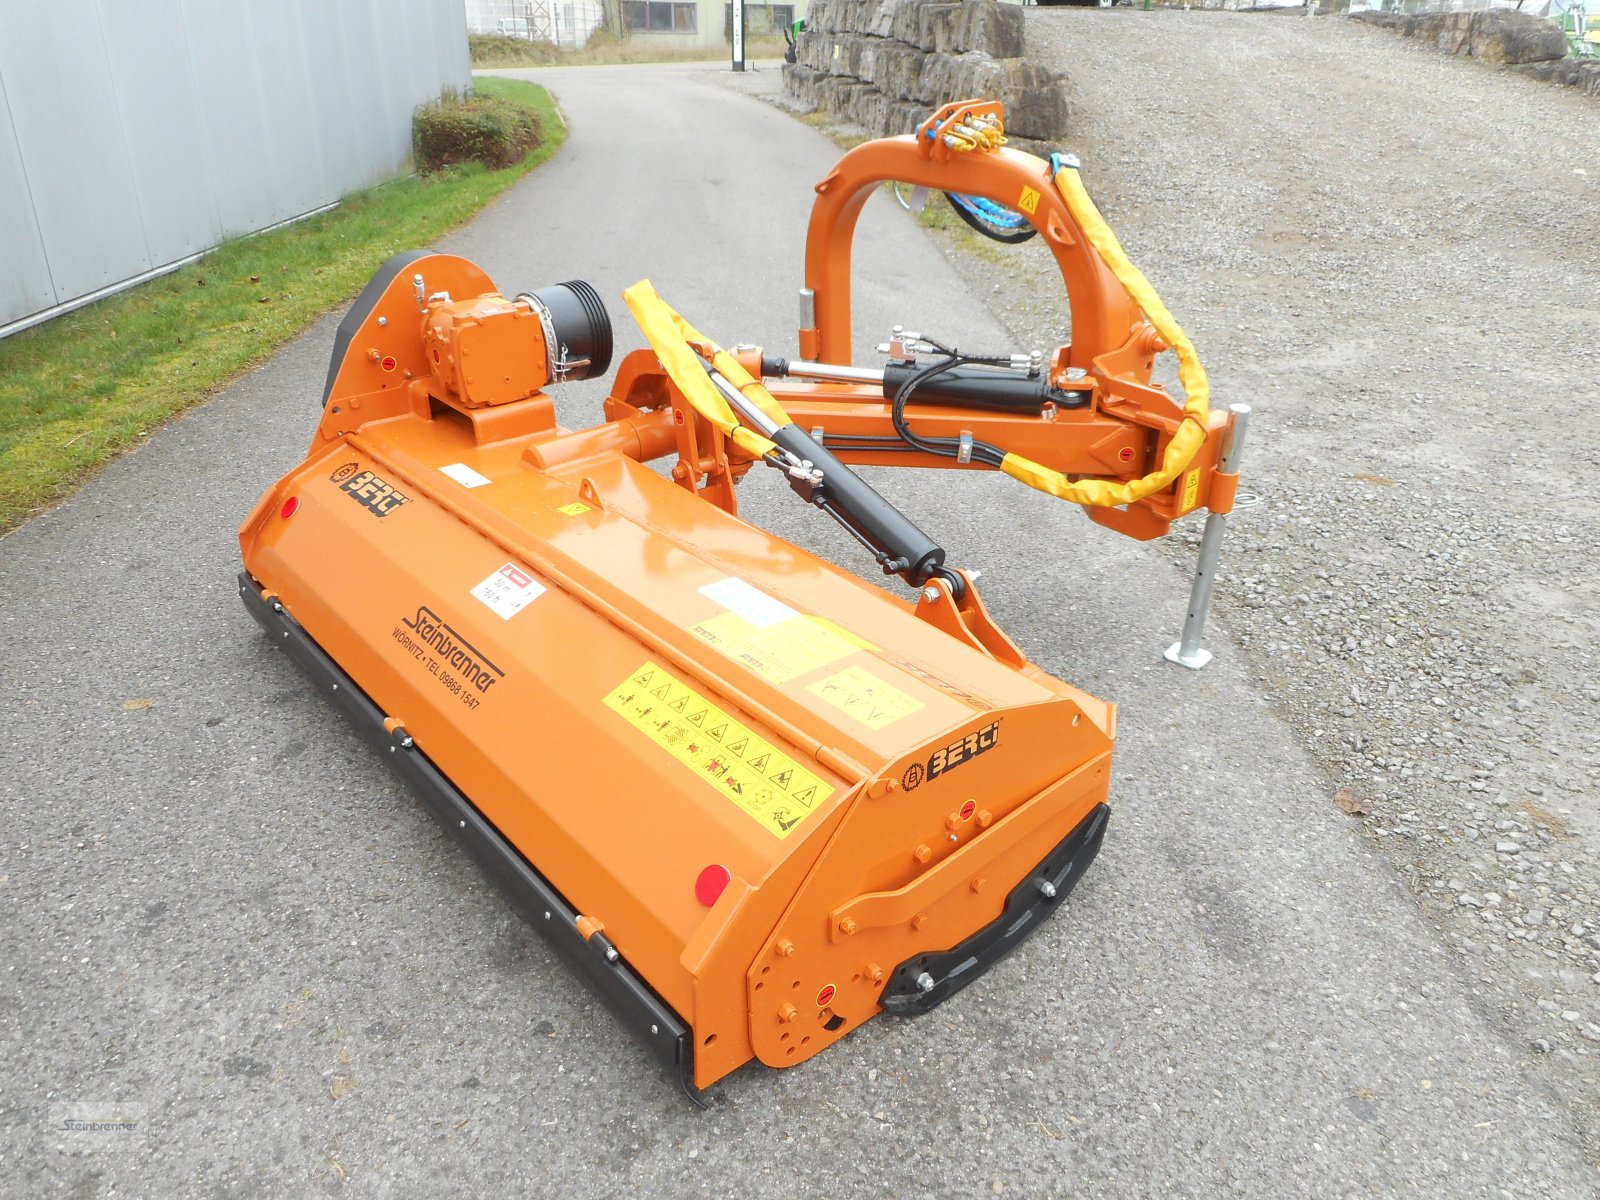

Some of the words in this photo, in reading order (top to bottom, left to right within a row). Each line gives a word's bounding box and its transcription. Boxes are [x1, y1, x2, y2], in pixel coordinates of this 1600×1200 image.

[392, 627, 424, 660] WÖRNITZ
[425, 657, 440, 676] TEL
[439, 671, 462, 695] 09868
[460, 690, 480, 710] 1547
[401, 605, 497, 694] Steinbrenner
